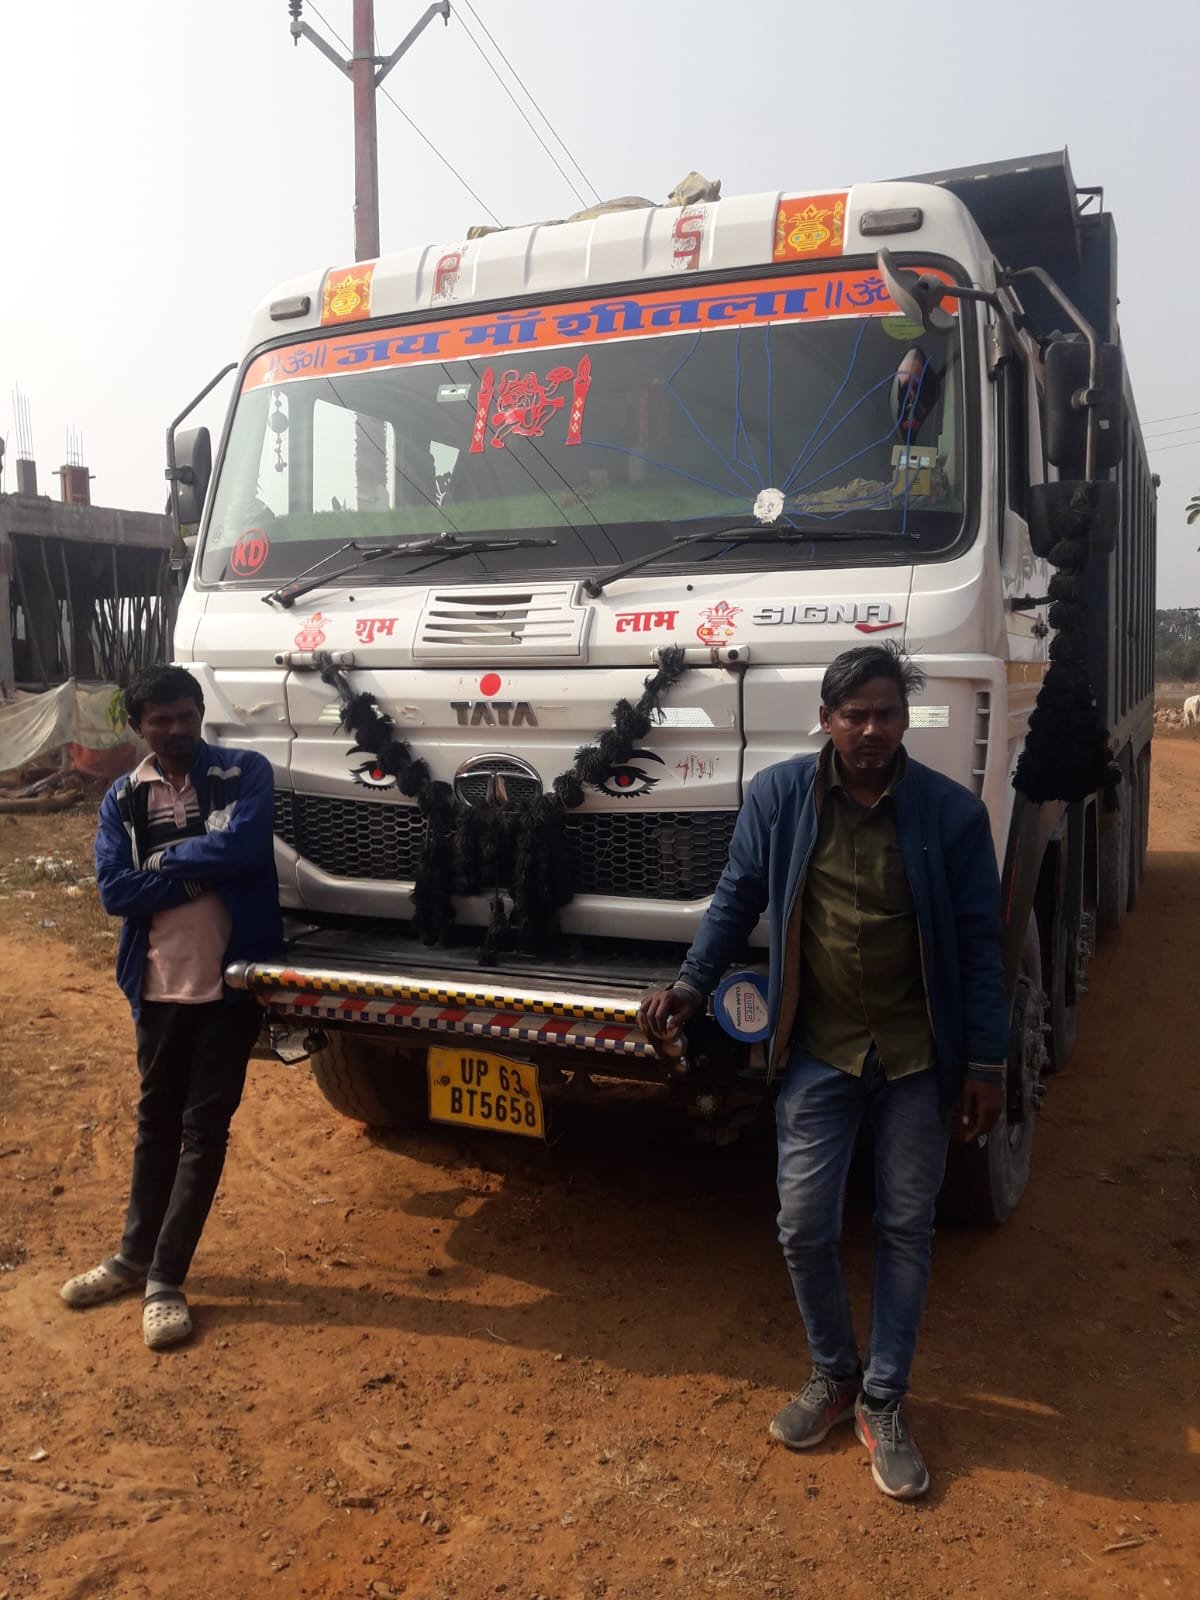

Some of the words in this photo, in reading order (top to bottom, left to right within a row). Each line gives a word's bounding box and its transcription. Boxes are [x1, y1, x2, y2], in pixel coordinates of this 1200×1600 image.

[333, 330, 450, 366] जय
[552, 287, 817, 337] शीतला
[233, 539, 264, 567] KD
[615, 610, 680, 633] लाभ
[752, 602, 891, 626] SIGNA
[355, 617, 399, 643] शुभ
[450, 701, 539, 727] TATA
[461, 1058, 489, 1087] UP
[451, 1086, 536, 1128] BT5658
